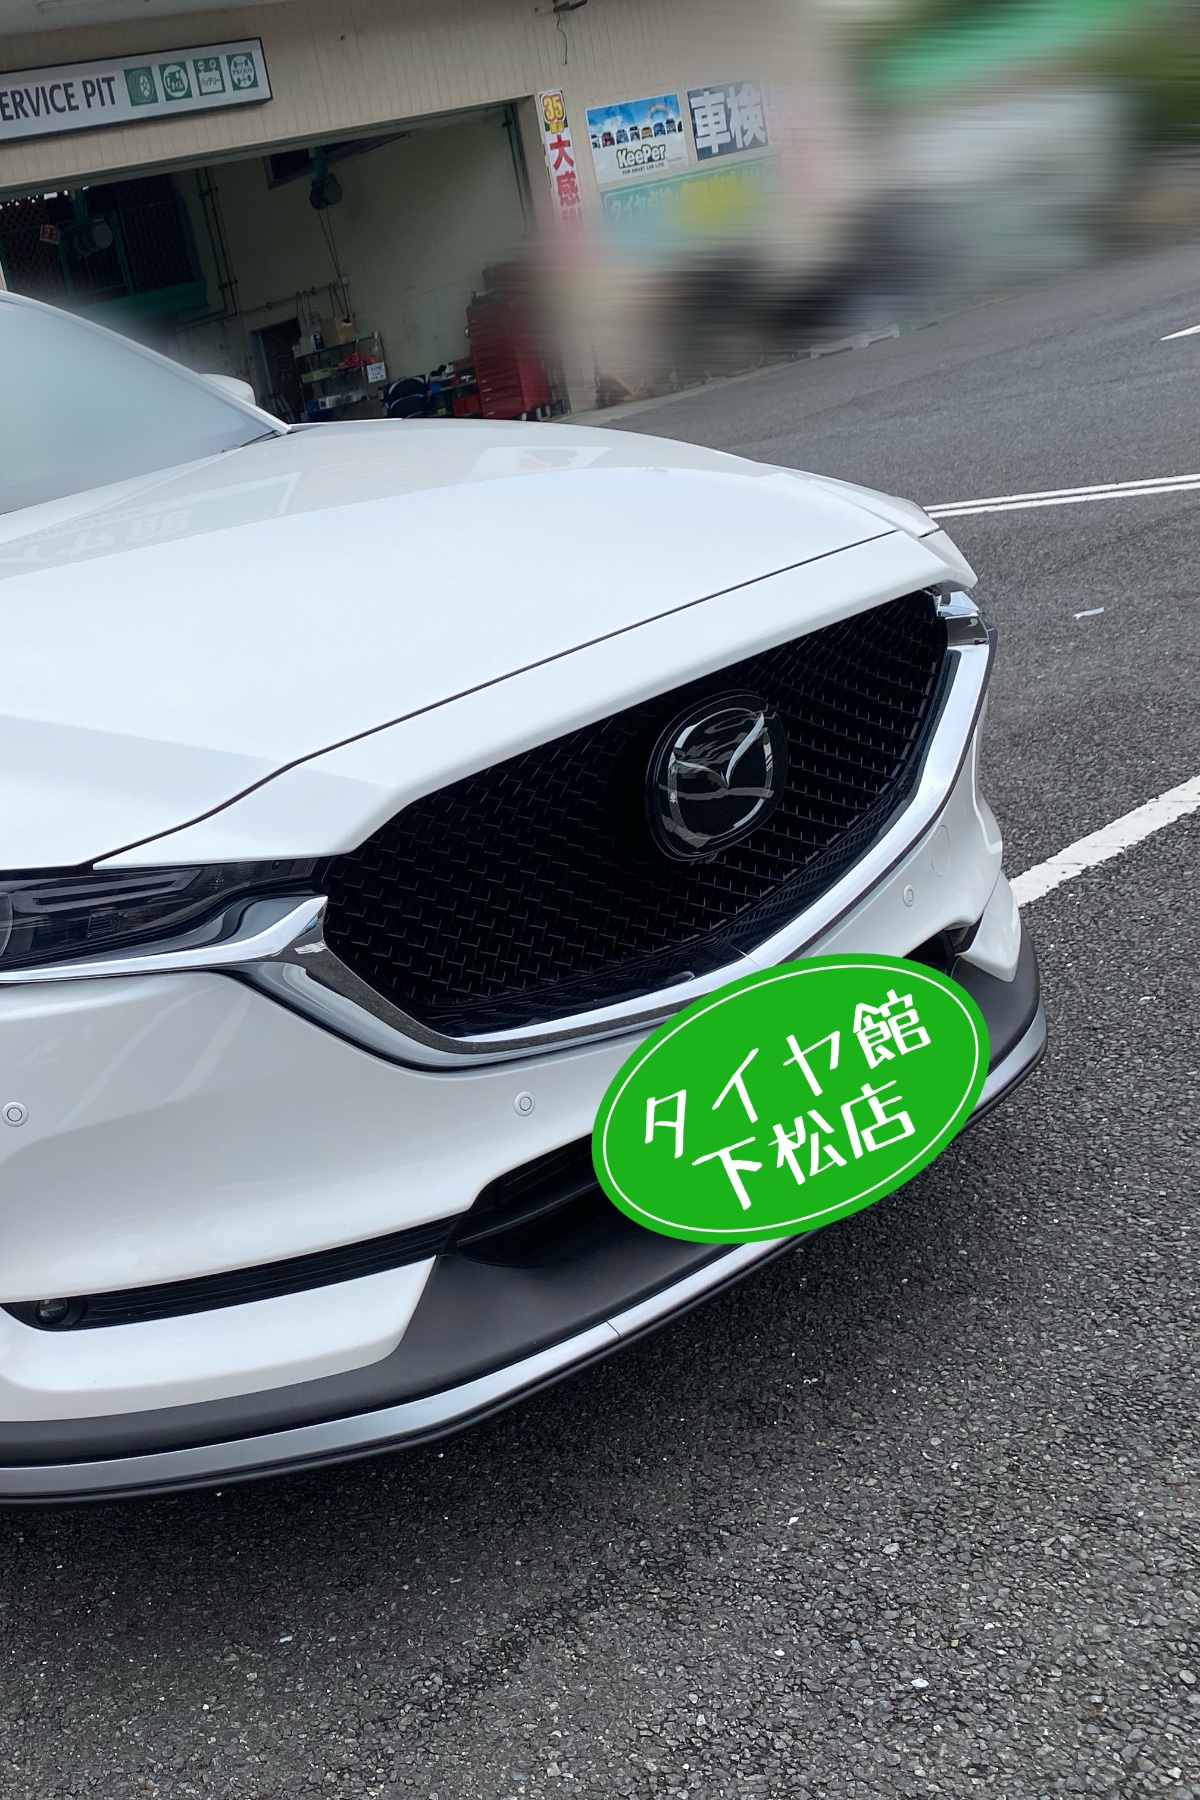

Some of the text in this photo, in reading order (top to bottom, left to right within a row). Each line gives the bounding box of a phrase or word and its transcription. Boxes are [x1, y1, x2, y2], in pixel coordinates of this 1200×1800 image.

[83, 76, 116, 107] PIT
[542, 93, 565, 122] 35
[690, 83, 766, 154] 車検
[616, 144, 666, 169] KeePer
